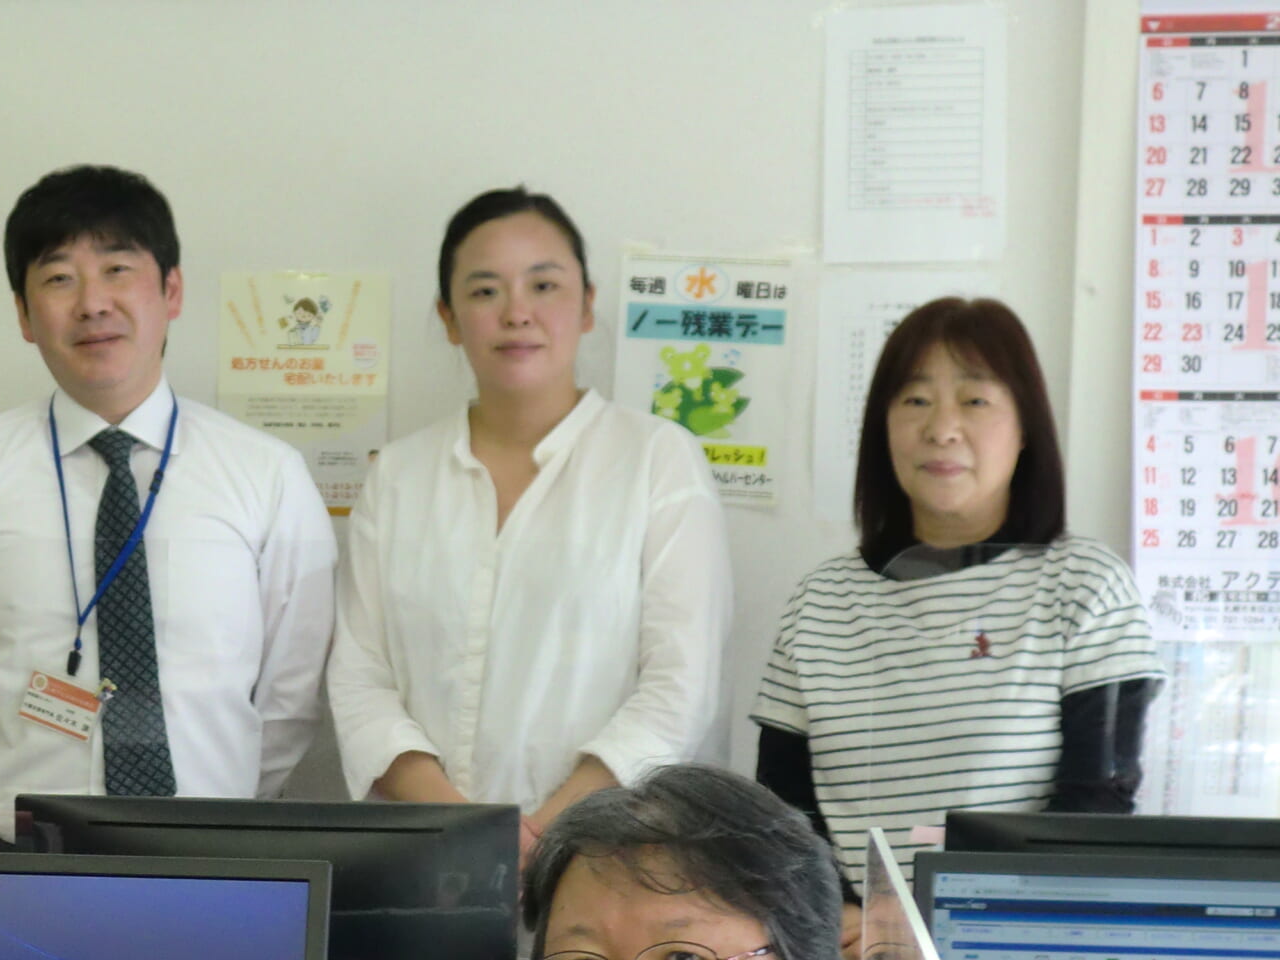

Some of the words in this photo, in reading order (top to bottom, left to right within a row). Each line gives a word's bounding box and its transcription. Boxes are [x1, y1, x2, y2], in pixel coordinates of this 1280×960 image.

[1242, 50, 1249, 68] 1
[1152, 82, 1164, 101] 6
[1196, 81, 1207, 101] 7
[1238, 81, 1249, 100] 8
[1149, 114, 1166, 133] 13
[1191, 114, 1208, 133] 14
[1234, 113, 1252, 132] 15
[1146, 147, 1167, 166] 20
[1189, 146, 1208, 165] 21
[1230, 145, 1253, 165] 22
[1145, 178, 1166, 197] 27
[1186, 178, 1208, 197] 28
[1229, 177, 1251, 196] 29
[1151, 227, 1157, 246] 1
[1190, 228, 1201, 246] 2
[1232, 227, 1243, 246] 3
[1148, 259, 1160, 278] 8
[1189, 260, 1200, 278] 9
[1228, 259, 1246, 278] 10
[629, 276, 667, 295] 毎週
[684, 266, 718, 299] 水
[736, 280, 788, 299] 曜日は
[1145, 291, 1162, 309] 15
[1185, 291, 1202, 309] 16
[1227, 291, 1245, 310] 17
[631, 309, 784, 338] ノー残業デー
[1143, 322, 1163, 341] 22
[1182, 323, 1203, 342] 23
[1223, 323, 1244, 341] 24
[1142, 354, 1162, 373] 29
[1181, 355, 1202, 373] 30
[1146, 435, 1156, 453] 4
[1184, 435, 1194, 453] 5
[1224, 436, 1235, 454] 6
[1268, 435, 1278, 454] 7
[1144, 467, 1156, 484] 11
[1181, 467, 1196, 485] 12
[1221, 467, 1237, 485] 13
[1263, 467, 1278, 486] 14
[1144, 498, 1158, 516] 18
[1180, 499, 1196, 517] 19
[1218, 498, 1238, 517] 20
[1261, 498, 1278, 517] 21
[1142, 530, 1160, 548] 25
[1178, 530, 1196, 548] 26
[1216, 530, 1236, 548] 27
[1258, 530, 1279, 549] 28
[1158, 575, 1211, 589] 株式会社
